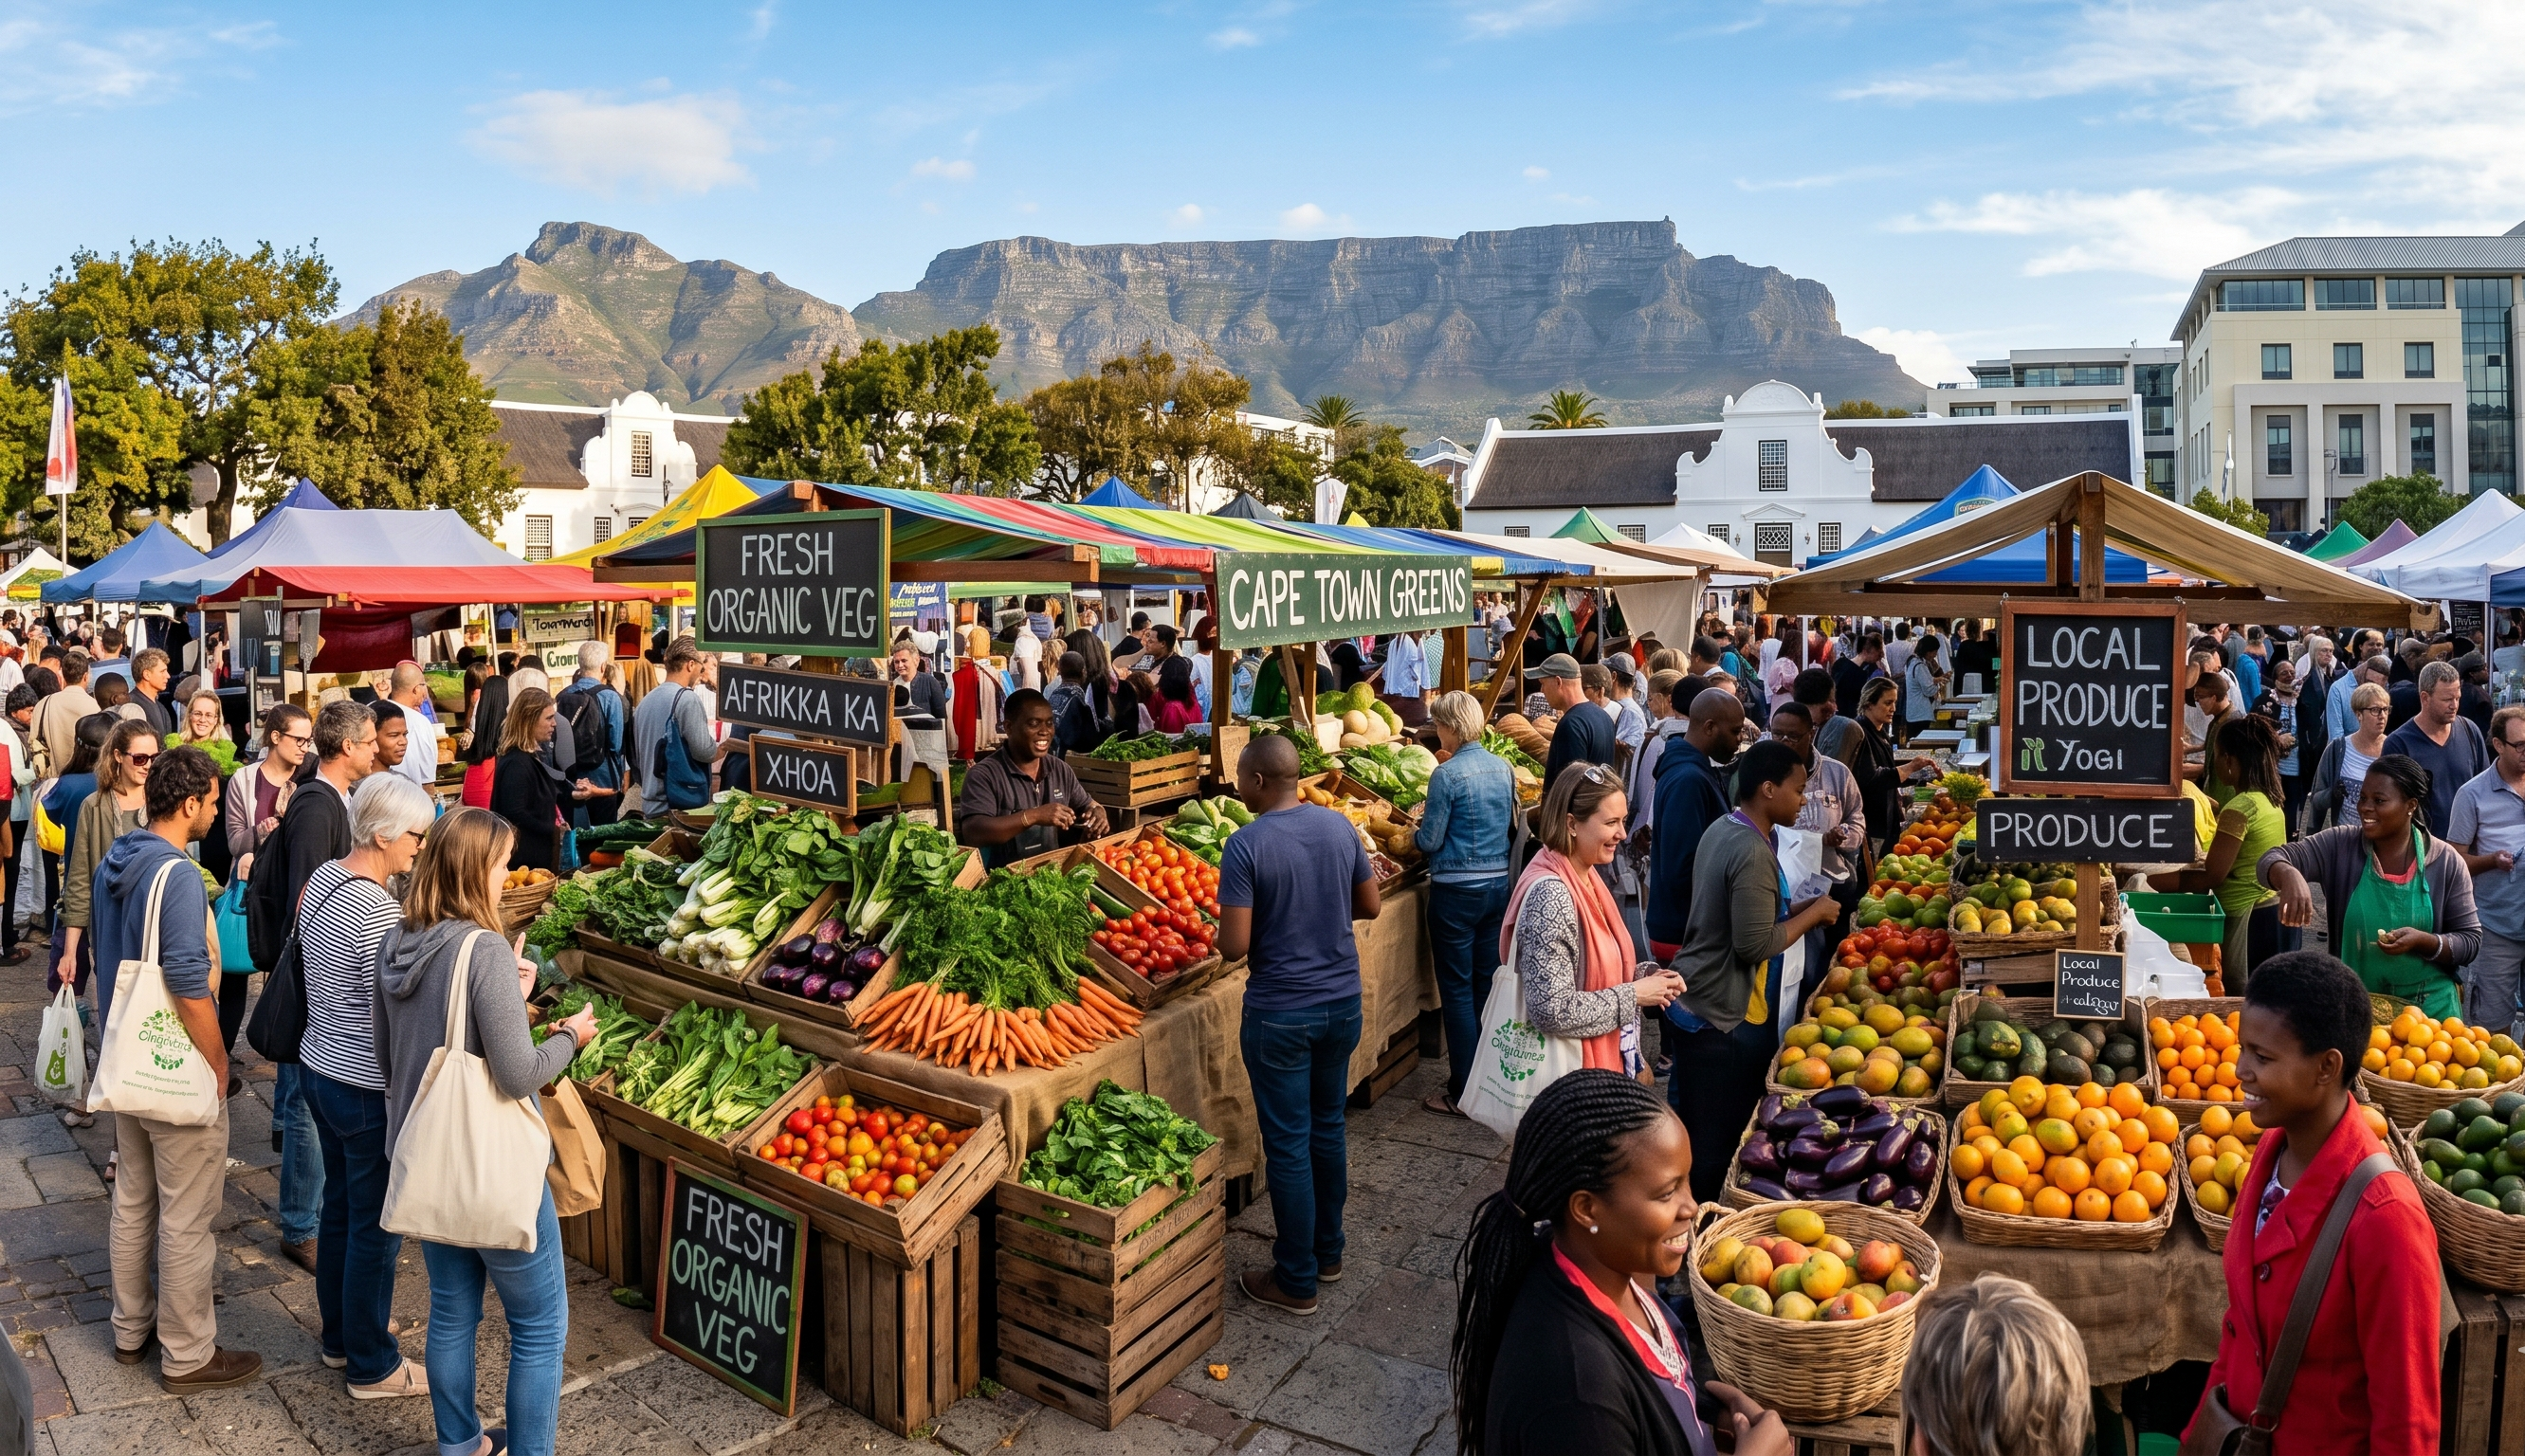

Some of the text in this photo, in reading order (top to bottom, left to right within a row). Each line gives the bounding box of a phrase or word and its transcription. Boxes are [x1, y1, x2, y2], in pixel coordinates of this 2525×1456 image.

[741, 531, 833, 576] FRESH
[707, 586, 877, 639] ORGANIC VEG
[1229, 567, 1466, 630] CAPE TOWN GREENS
[2027, 625, 2161, 670] LOCAL
[724, 677, 879, 733] AFRIKKA KA
[2019, 680, 2168, 729] PRODUCE
[766, 752, 836, 796] XHOA
[1990, 812, 2173, 847] PRODUCE
[2061, 971, 2120, 989] Produce
[2062, 956, 2099, 970] Local
[686, 1187, 783, 1273] FRESH
[672, 1238, 790, 1336] ORGANIC
[695, 1301, 758, 1374] VEG
